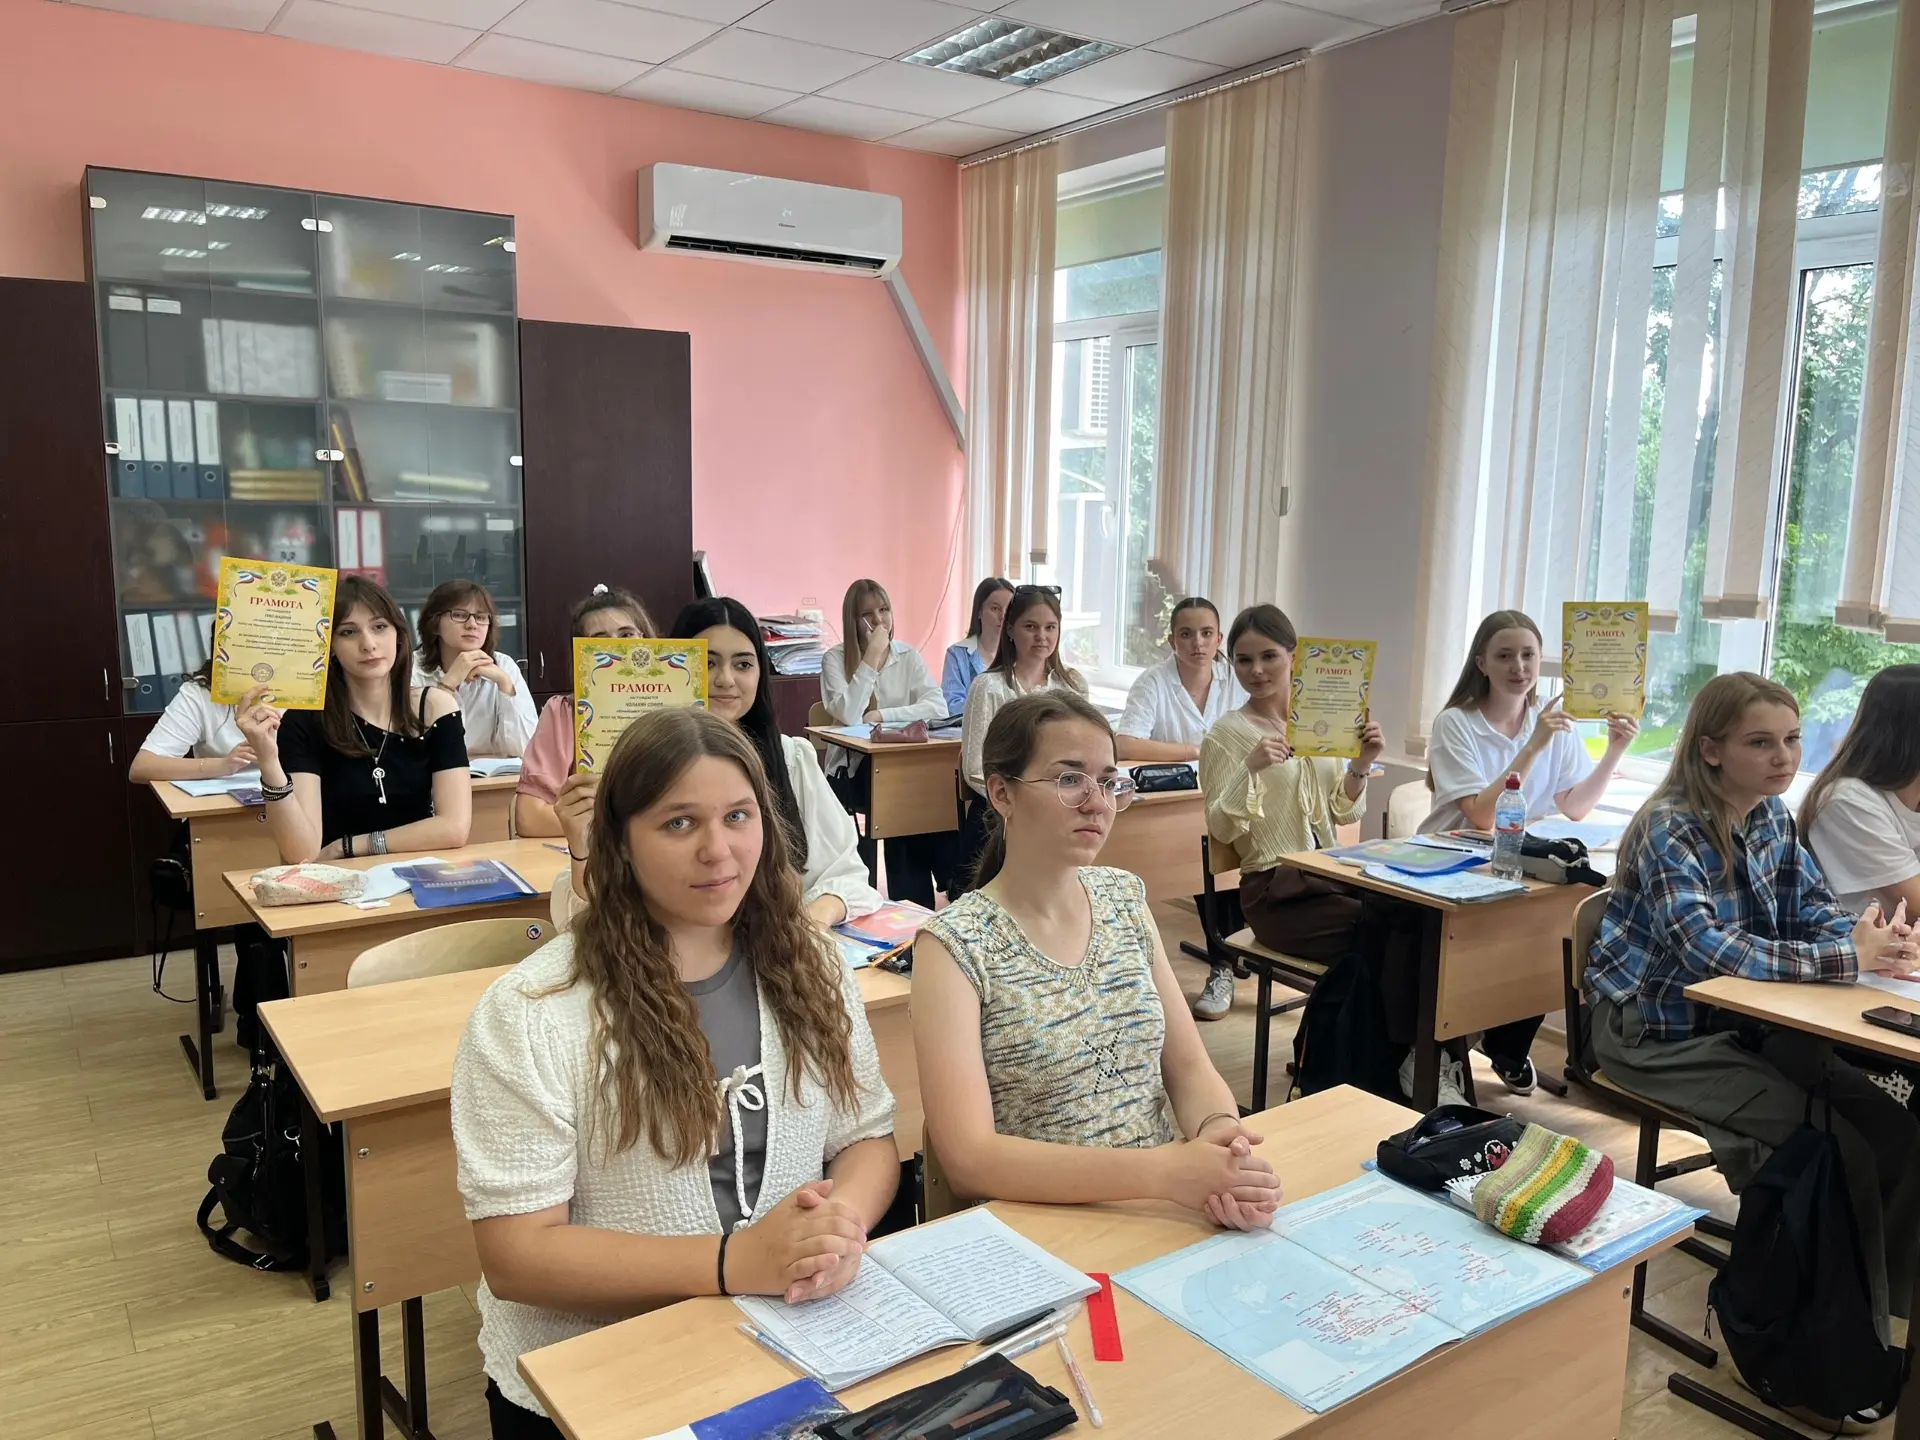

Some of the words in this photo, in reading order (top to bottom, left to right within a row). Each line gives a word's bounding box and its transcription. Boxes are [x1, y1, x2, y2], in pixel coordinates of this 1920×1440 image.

[249, 596, 304, 610] ГРАМОТА
[1585, 629, 1626, 637] ГРАМОТА
[1315, 667, 1352, 676] ГРАМОТА
[610, 683, 672, 693] ГРАМОТА
